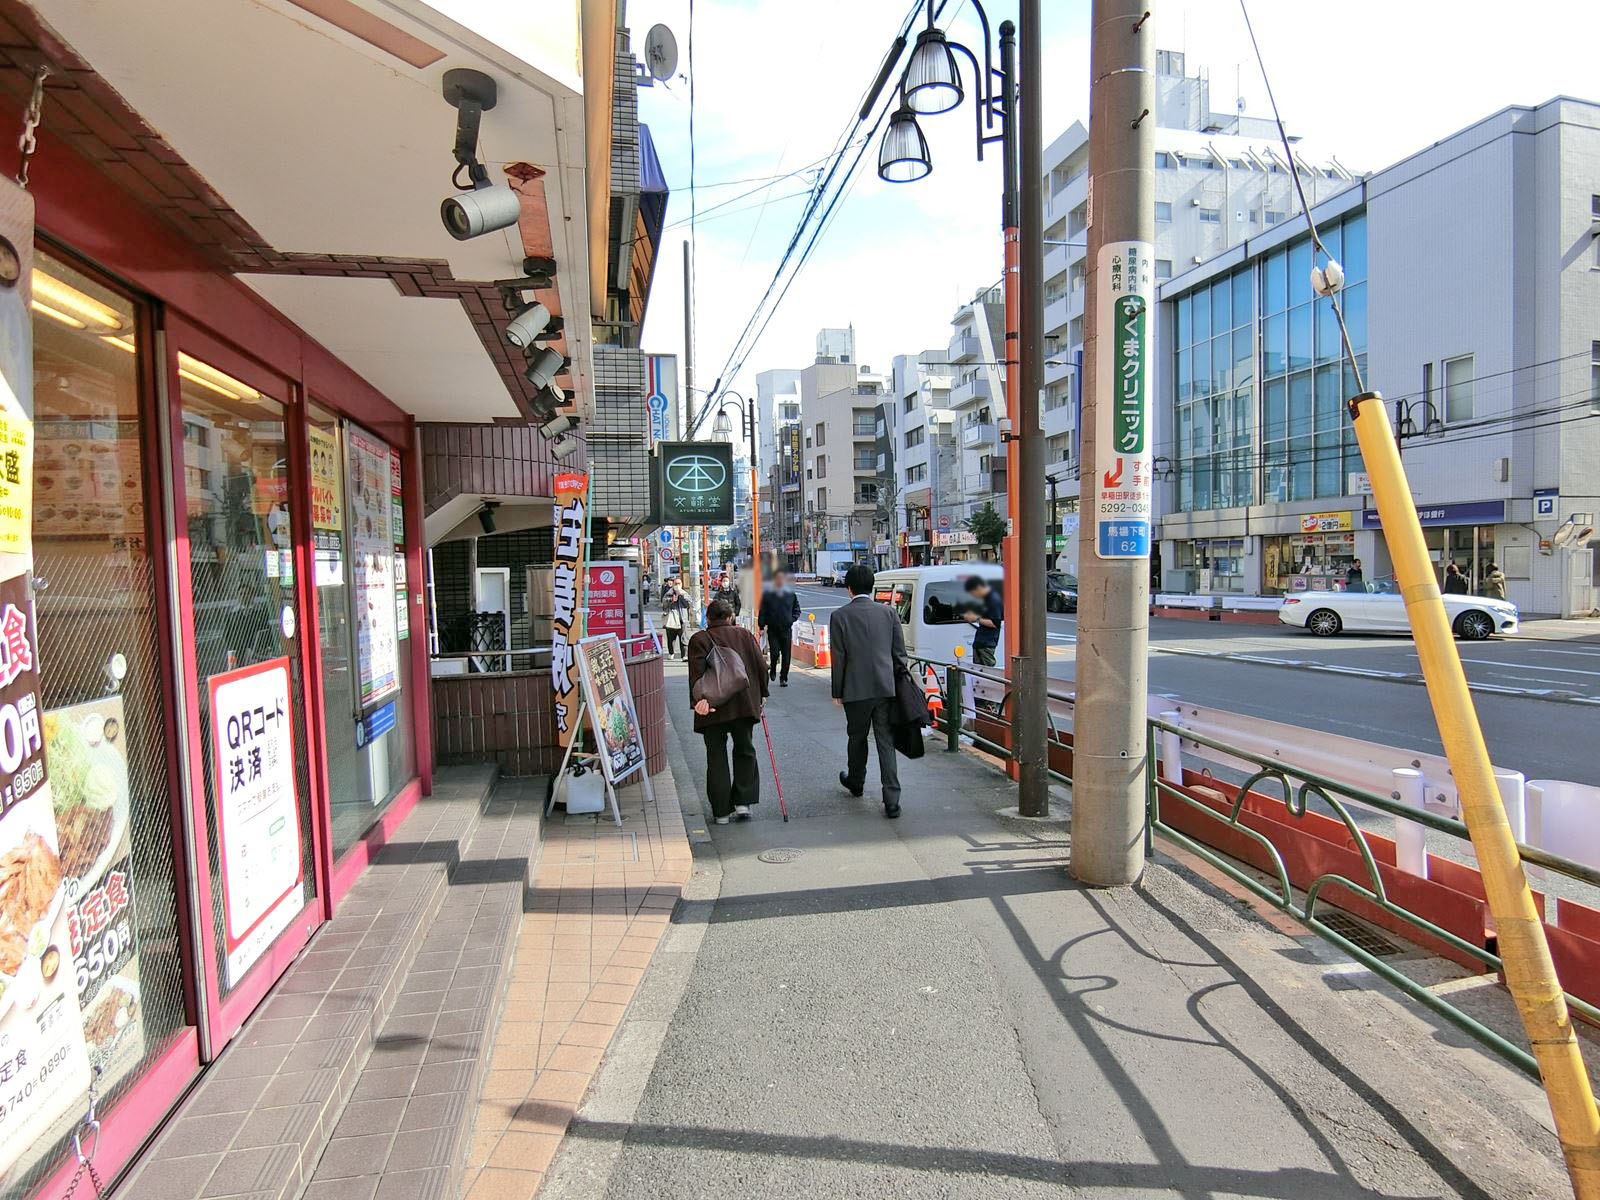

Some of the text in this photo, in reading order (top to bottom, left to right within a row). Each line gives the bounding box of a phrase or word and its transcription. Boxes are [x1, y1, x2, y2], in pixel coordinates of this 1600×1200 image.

[1112, 255, 1122, 291] 心療内科
[1128, 248, 1137, 293] 糖尿病内科
[1142, 259, 1149, 284] 内科
[1121, 298, 1141, 451] さくまクリニック
[1541, 501, 1551, 512] P
[1107, 526, 1146, 537] 馬場下町
[1121, 541, 1137, 552] 62
[227, 697, 285, 750] QRコード
[230, 745, 262, 794] 決済
